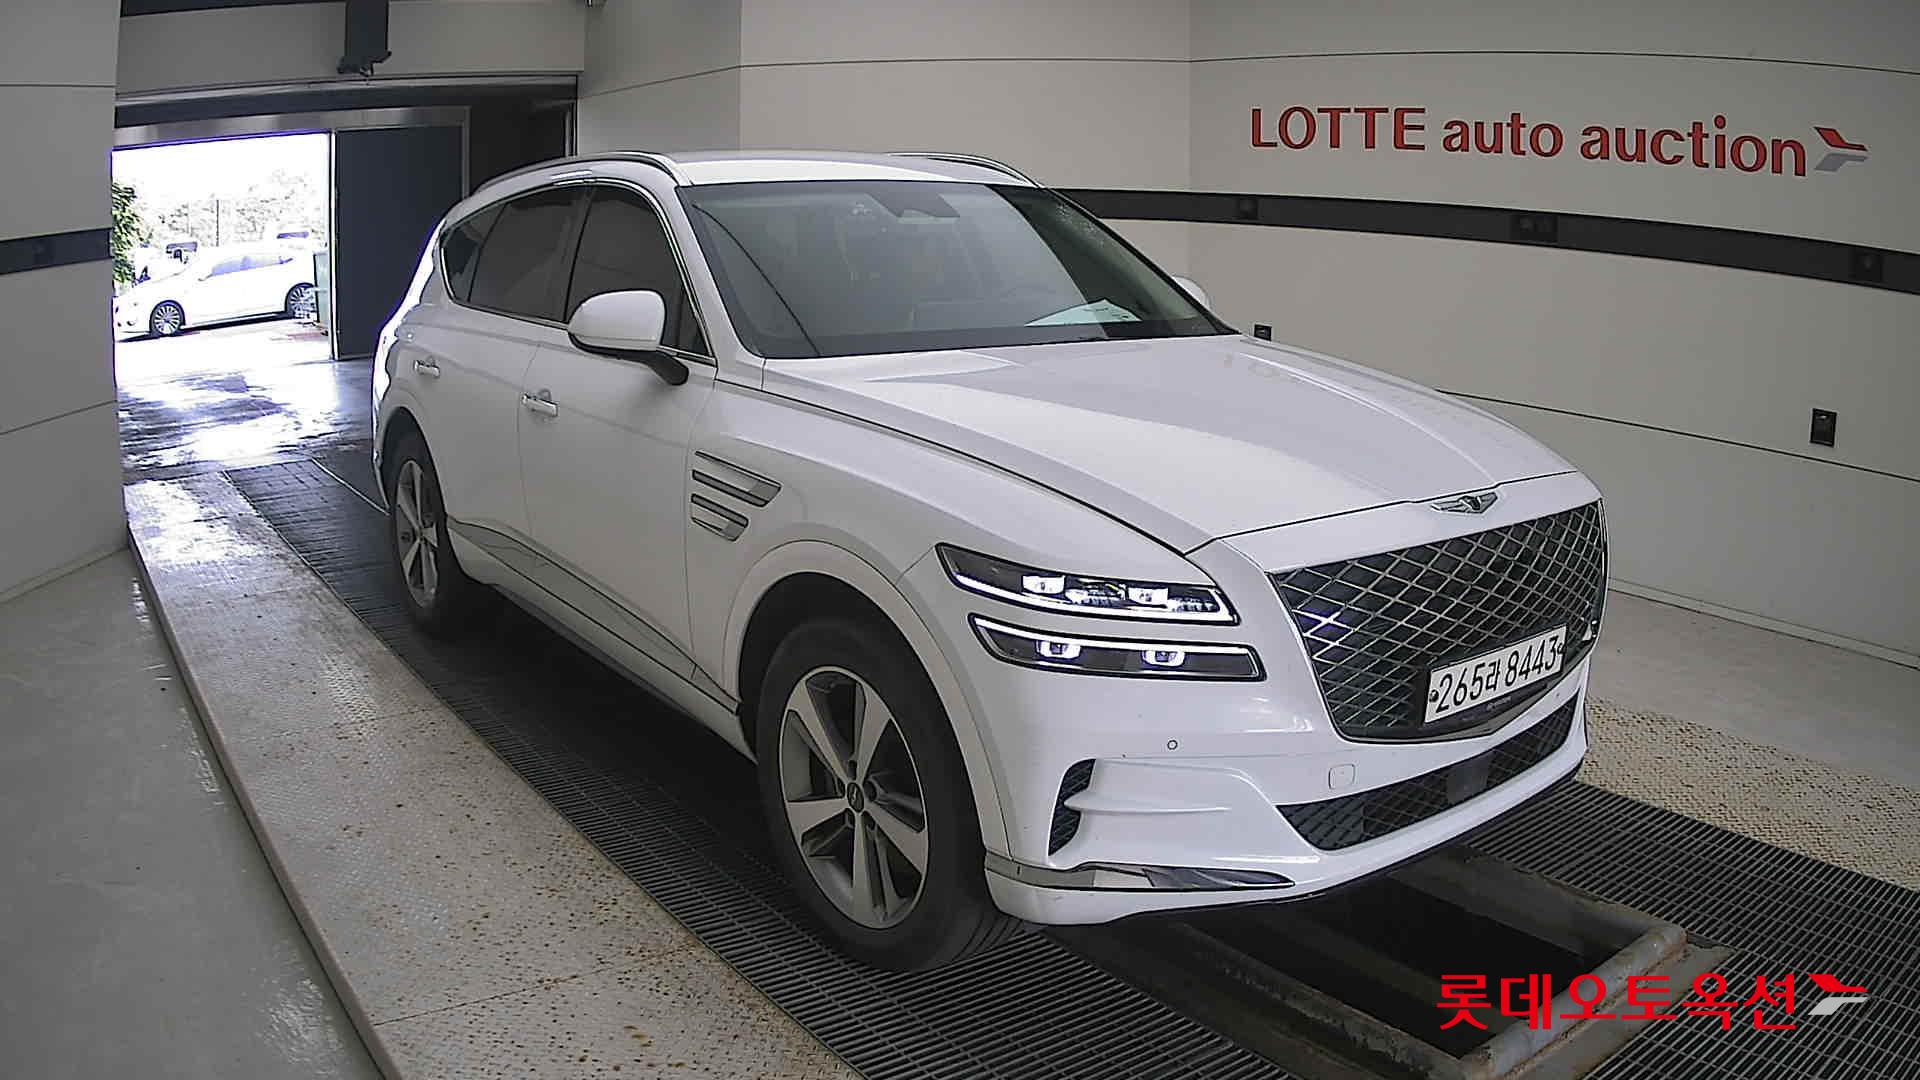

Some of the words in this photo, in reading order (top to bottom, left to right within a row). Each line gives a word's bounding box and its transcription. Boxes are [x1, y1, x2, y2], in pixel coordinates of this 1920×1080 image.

[1250, 106, 1426, 151] LOTTE
[1443, 113, 1565, 157] auto
[1581, 115, 1808, 177] auction
[1435, 658, 1501, 714] 265라
[1504, 634, 1560, 687] 8443
